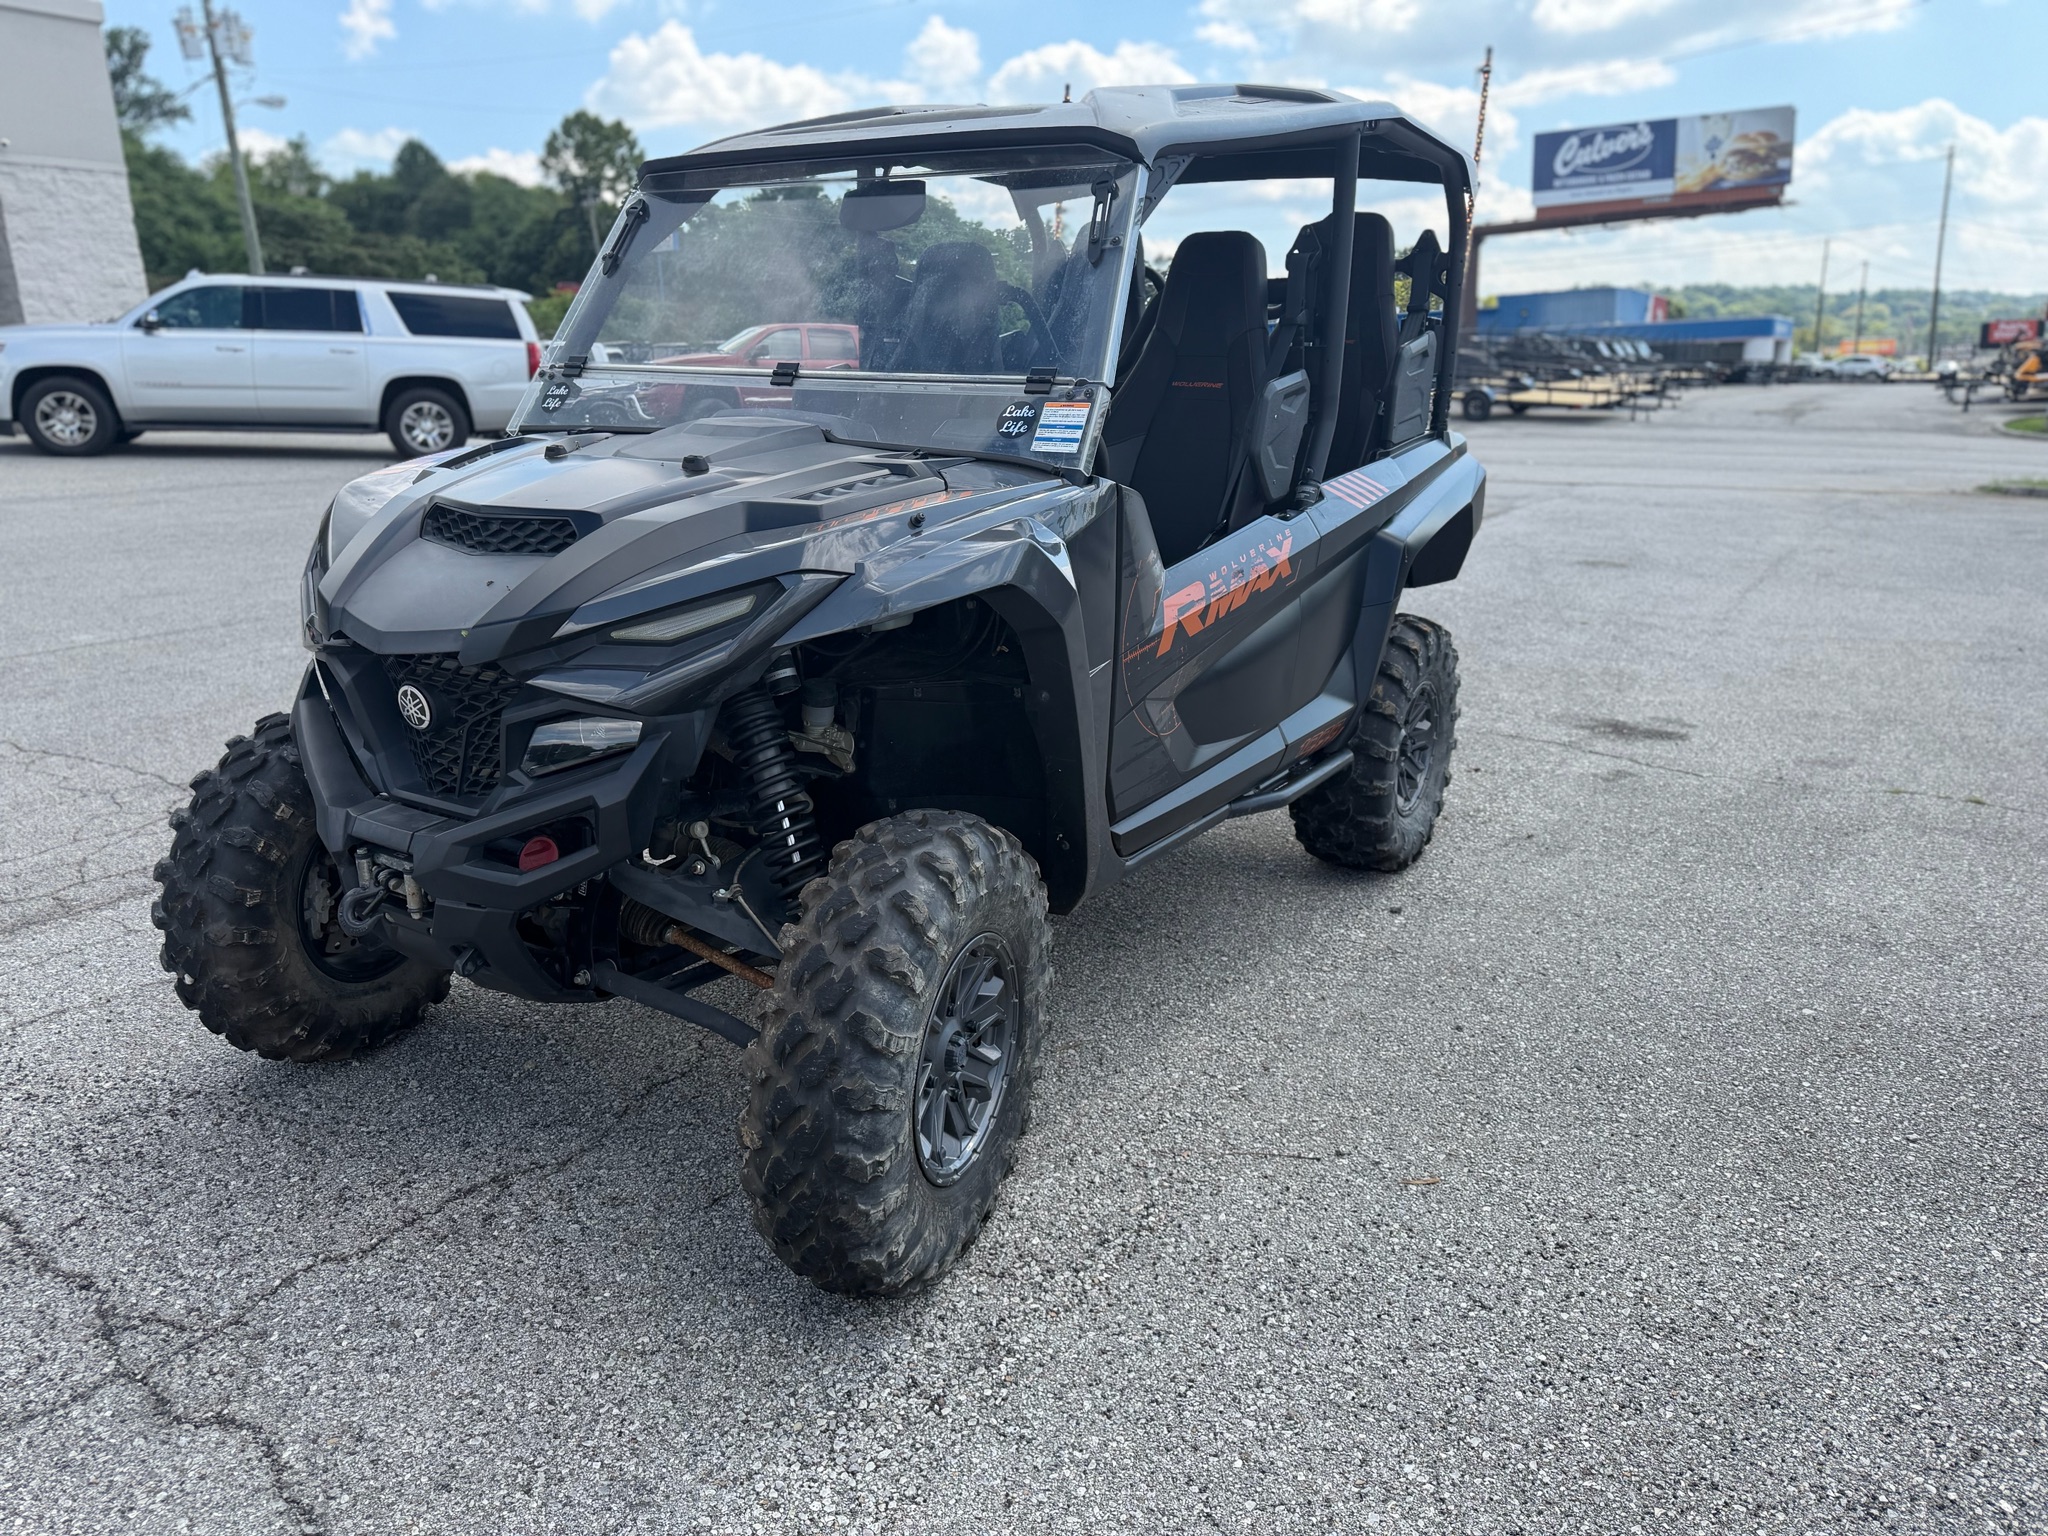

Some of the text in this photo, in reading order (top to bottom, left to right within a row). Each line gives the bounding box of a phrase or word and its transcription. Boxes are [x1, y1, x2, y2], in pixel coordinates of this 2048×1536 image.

[547, 385, 569, 395] Lake
[541, 397, 562, 410] Life
[1002, 404, 1035, 417] Lake
[999, 420, 1028, 436] Life
[1208, 528, 1292, 582] WOLVERINE
[1156, 536, 1293, 659] RMAX
